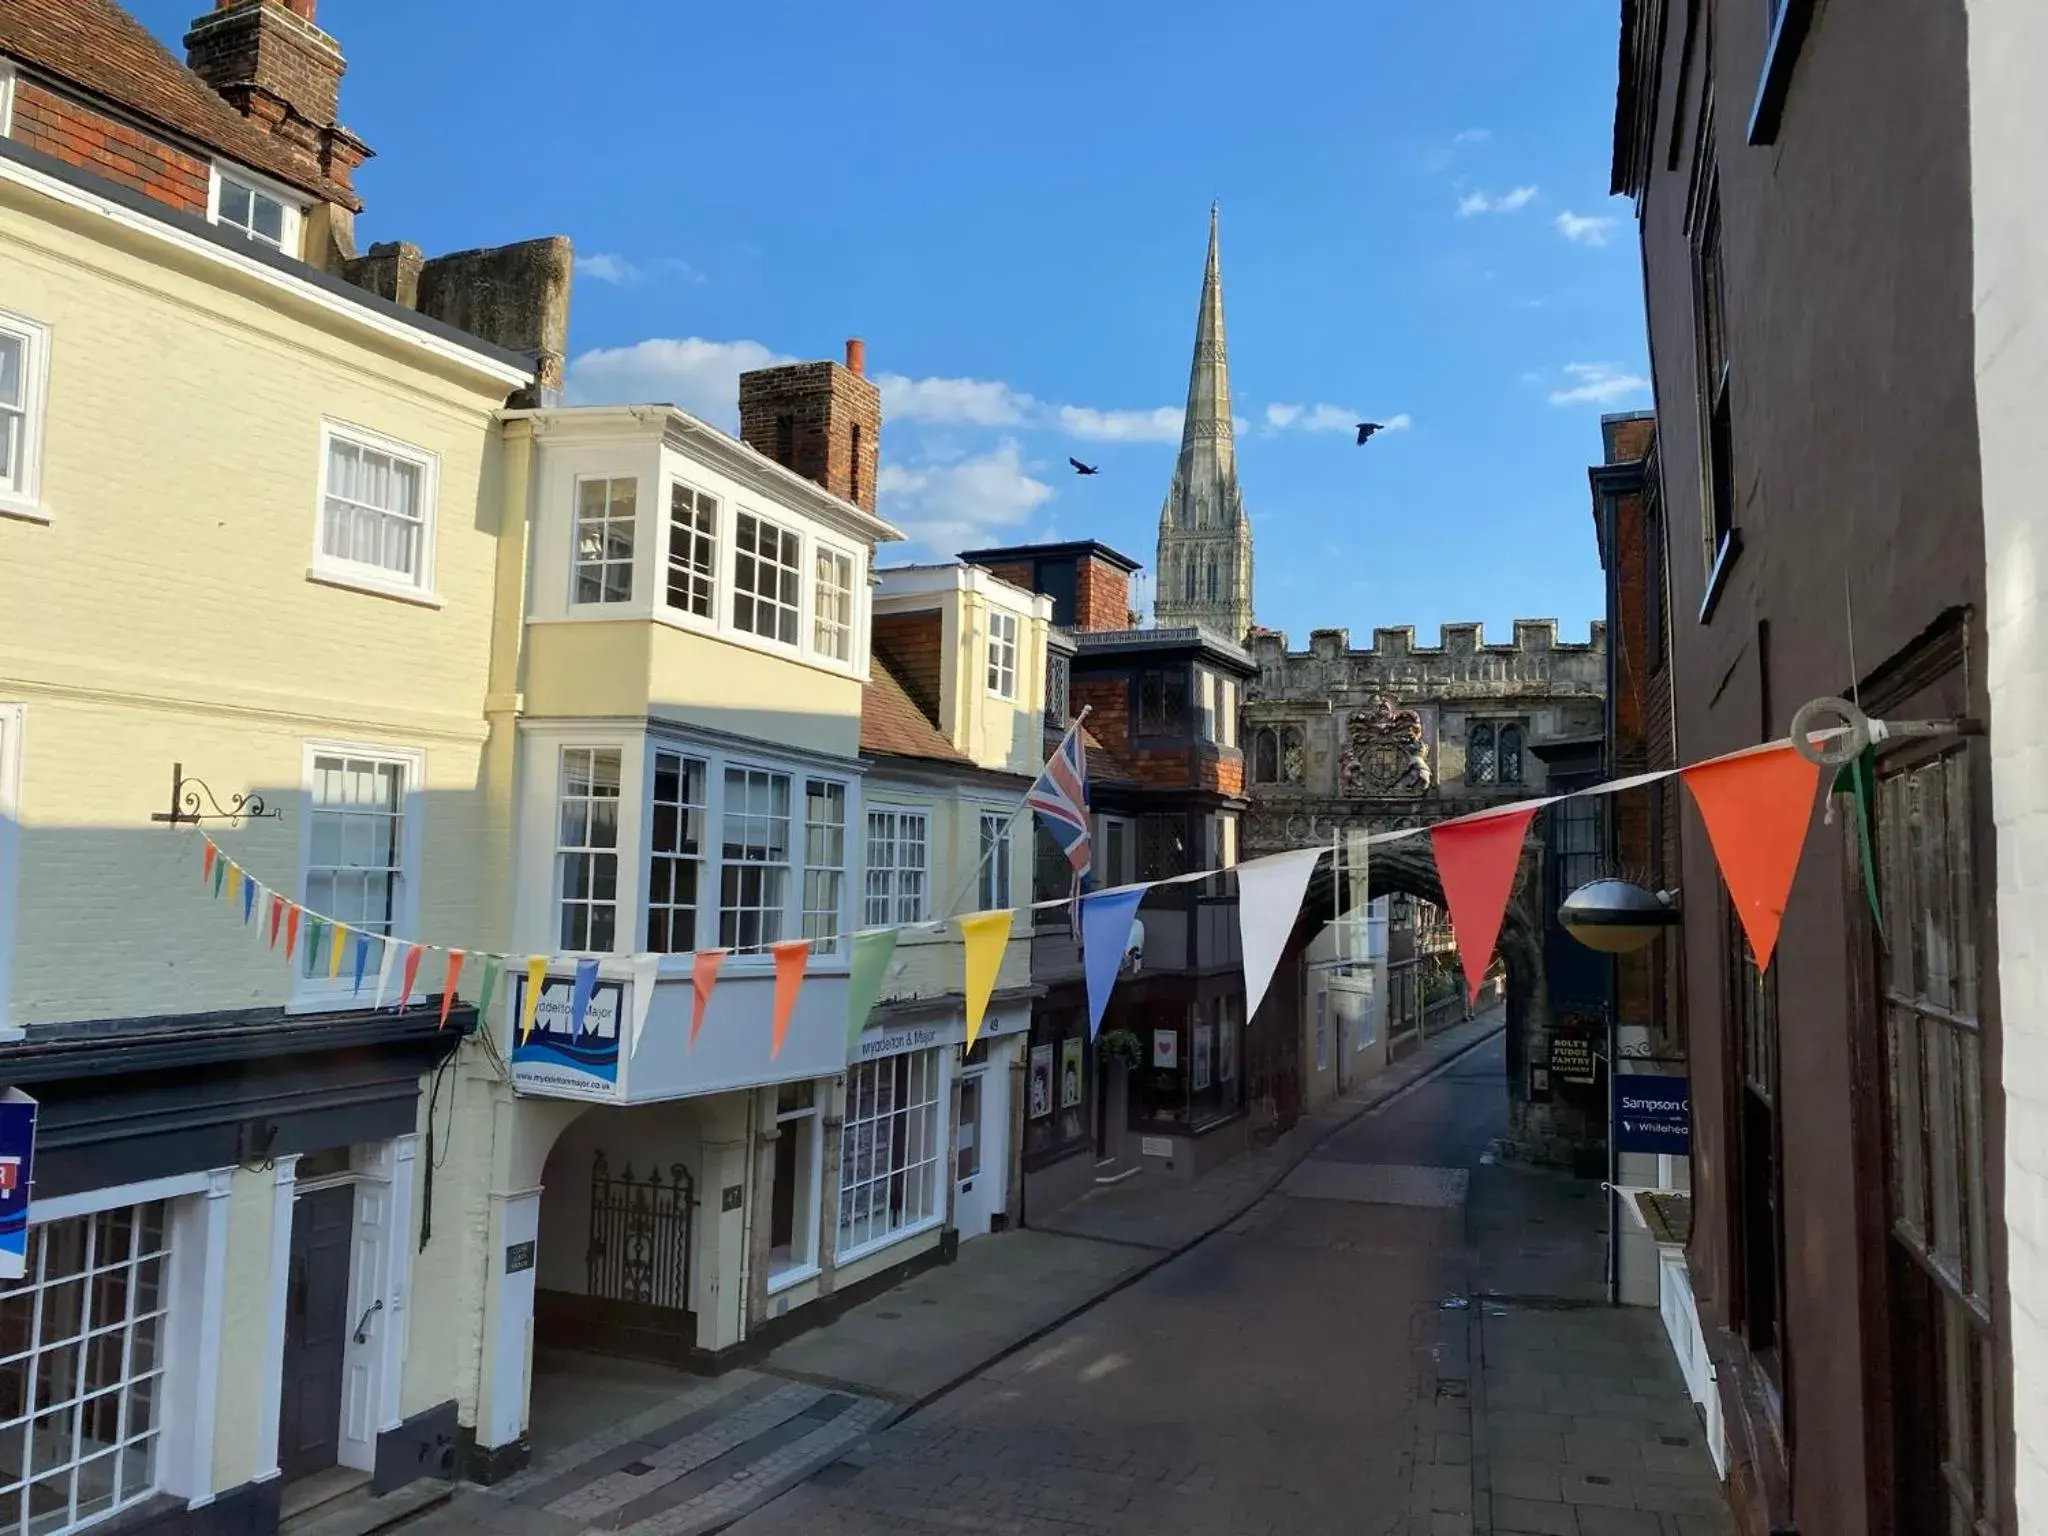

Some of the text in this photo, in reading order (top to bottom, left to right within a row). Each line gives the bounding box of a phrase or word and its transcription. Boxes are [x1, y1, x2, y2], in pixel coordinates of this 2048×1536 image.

[862, 1029, 936, 1056] Myddelton & Major
[1553, 1048, 1588, 1056] FUDGE
[1552, 1056, 1590, 1065] PANTRY
[1622, 1096, 1680, 1112] Sampson
[1639, 1122, 1689, 1135] Whitehea
